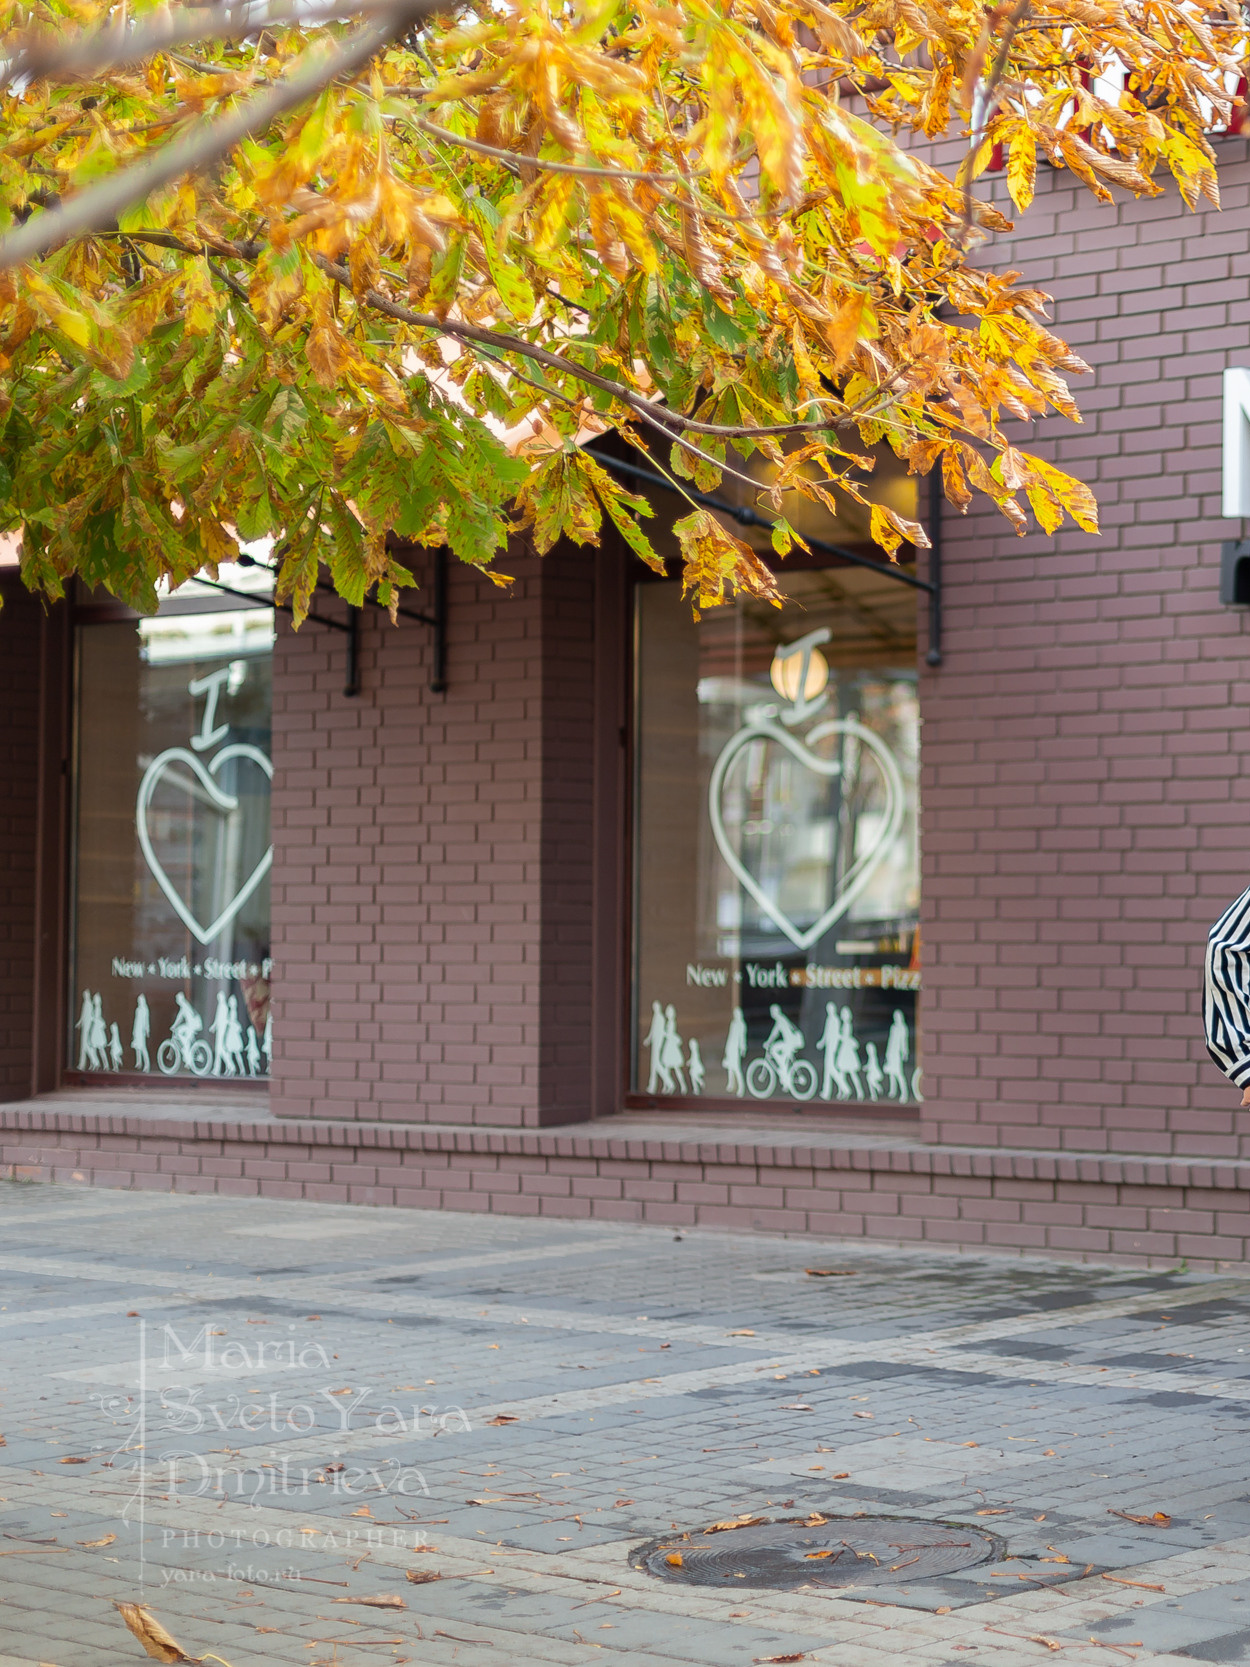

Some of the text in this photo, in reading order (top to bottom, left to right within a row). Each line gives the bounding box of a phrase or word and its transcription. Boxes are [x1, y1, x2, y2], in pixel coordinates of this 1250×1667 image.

[112, 956, 145, 978] New
[158, 955, 191, 979] York
[204, 956, 247, 980] Street
[687, 963, 728, 987] New
[747, 962, 789, 989] York
[805, 963, 862, 989] Street
